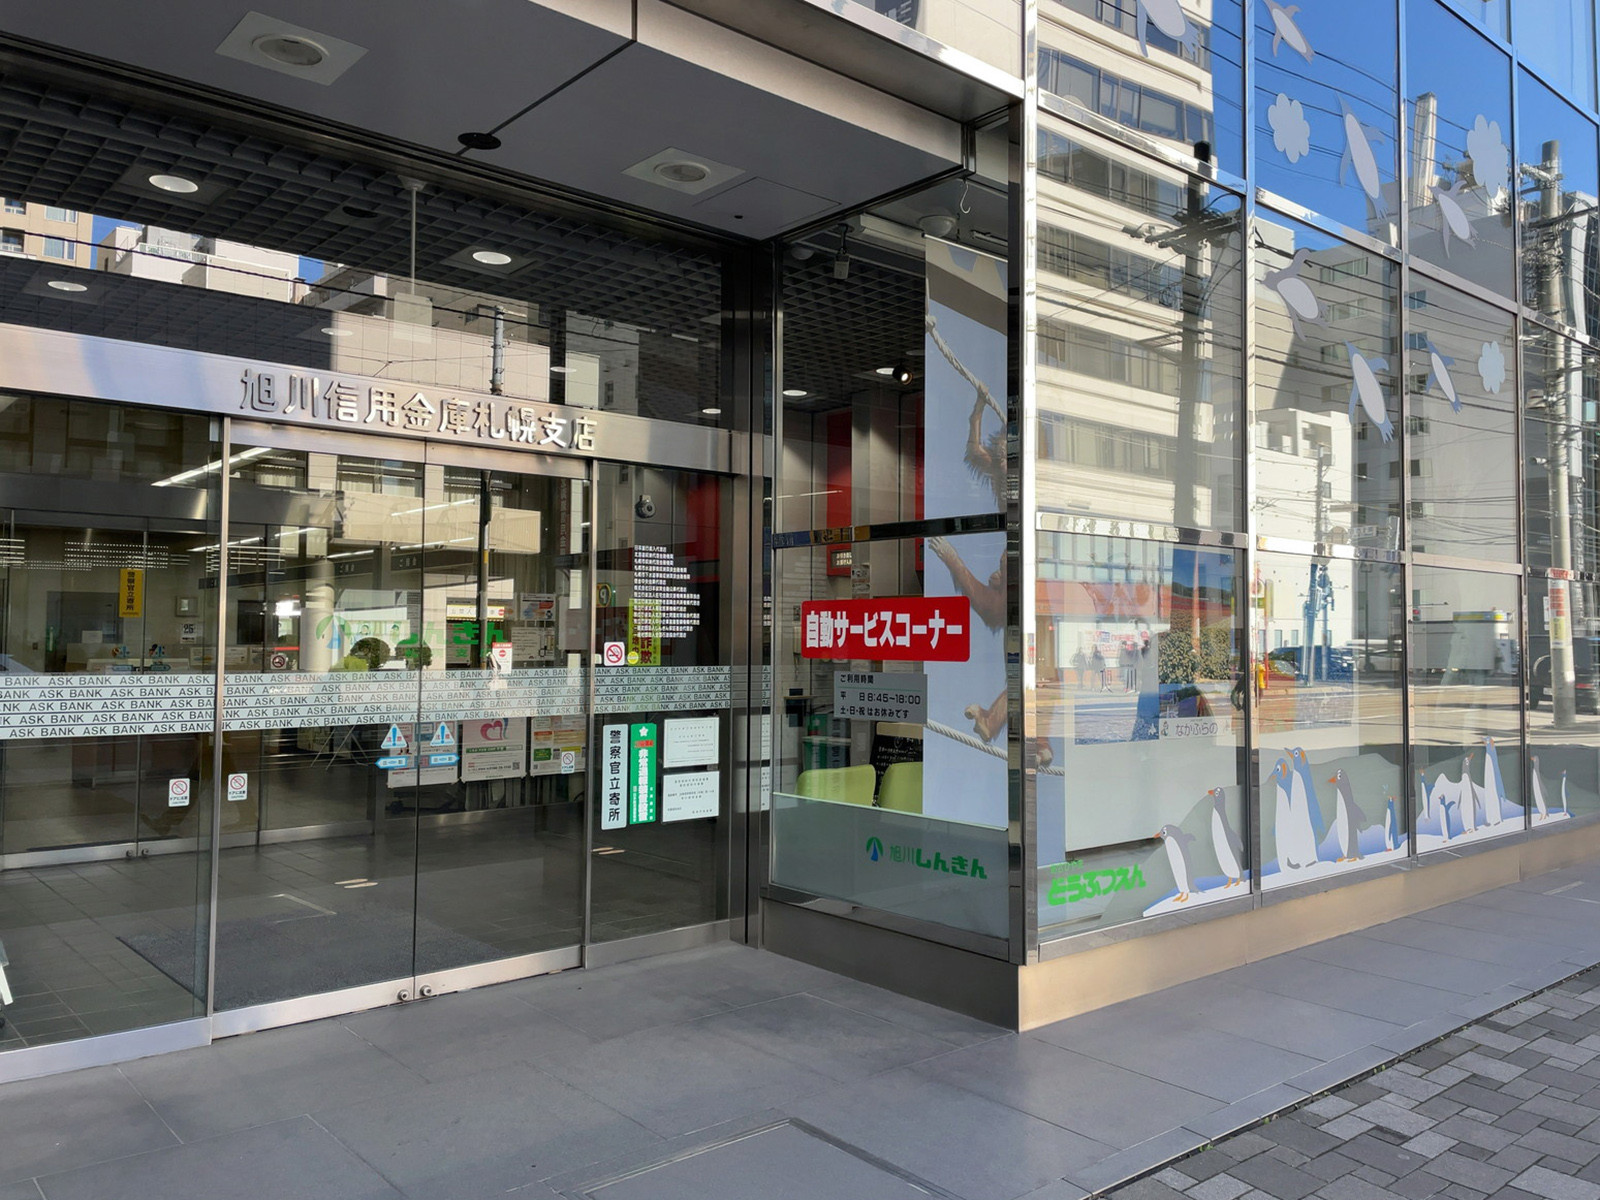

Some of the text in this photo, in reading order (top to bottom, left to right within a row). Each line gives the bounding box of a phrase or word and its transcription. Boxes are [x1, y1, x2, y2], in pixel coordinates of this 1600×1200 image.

[240, 369, 598, 450] 旭川信用金庫札幌支店
[806, 610, 963, 649] 自動サービスコーナー
[4, 676, 209, 685] BANK ASK BANK ASK BANK ASK
[234, 674, 263, 682] BANK
[270, 674, 290, 682] ASK
[328, 673, 347, 681] ASK
[840, 674, 874, 684] ご利用時間
[38, 689, 63, 698] ASK
[69, 689, 101, 697] BANK
[110, 689, 134, 697] ASK
[139, 688, 171, 696] BANK
[178, 688, 201, 696] ASK
[226, 686, 255, 695] BANK
[321, 684, 340, 692] ASK
[398, 682, 428, 690] BANK
[432, 681, 450, 689] ASK
[28, 702, 54, 710] ASK
[59, 701, 92, 710] BANK
[101, 701, 124, 709] ASK
[130, 700, 162, 708] BANK
[170, 699, 192, 707] ASK
[254, 697, 275, 705] ASK
[280, 696, 307, 704] BANK
[313, 695, 333, 703] ASK
[337, 694, 363, 702] BANK
[370, 693, 388, 701] ASK
[426, 692, 443, 700] ASK
[447, 691, 470, 699] BANK
[475, 690, 491, 698] ASK
[246, 709, 268, 717] ASK
[272, 708, 300, 716] BANK
[306, 707, 326, 715] ASK
[330, 706, 357, 714] BANK
[489, 699, 511, 707] BANK
[535, 697, 556, 705] BANK
[19, 715, 44, 724] ASK
[50, 714, 84, 723] BANK
[92, 713, 116, 722] ASK
[121, 713, 153, 721] BANK
[161, 712, 184, 720] ASK
[239, 720, 260, 728] ASK
[264, 719, 292, 727] BANK
[300, 717, 319, 725] ASK
[323, 716, 349, 724] BANK
[356, 715, 374, 723] ASK
[378, 714, 403, 722] BANK
[434, 712, 458, 720] BANK
[483, 709, 506, 717] BANK
[510, 708, 525, 716] ASK
[529, 707, 550, 715] BANK
[9, 722, 210, 737] ASK BANK ASK BANK ASK BANK
[608, 730, 622, 822] 警察官立寄所
